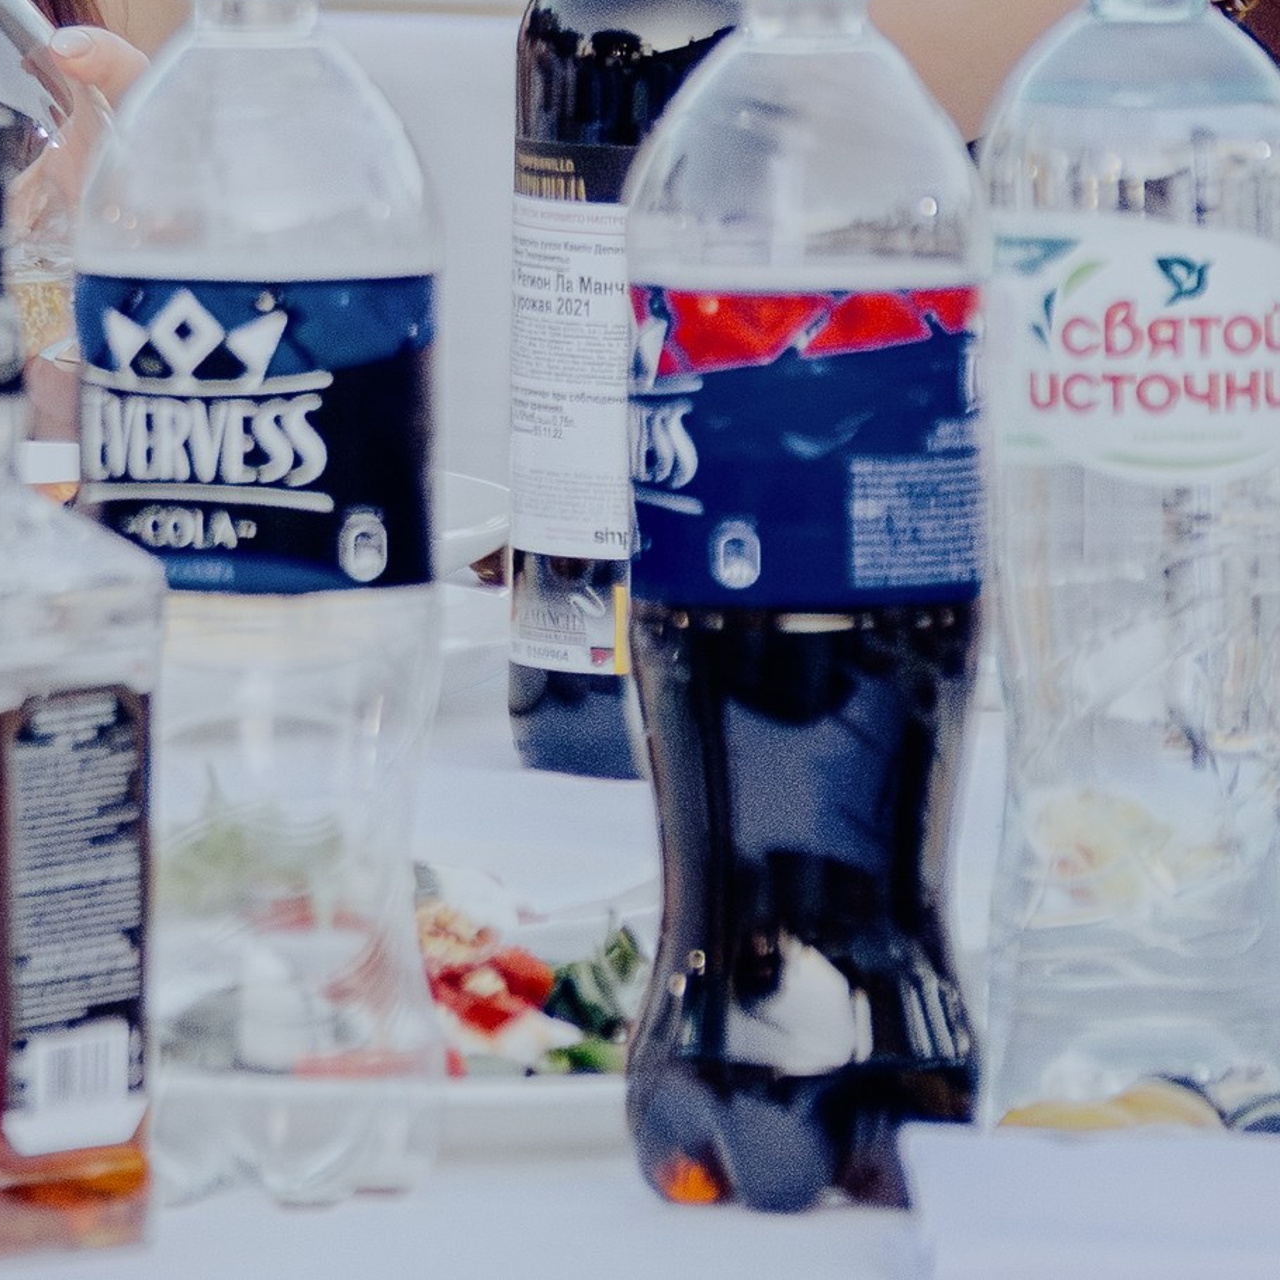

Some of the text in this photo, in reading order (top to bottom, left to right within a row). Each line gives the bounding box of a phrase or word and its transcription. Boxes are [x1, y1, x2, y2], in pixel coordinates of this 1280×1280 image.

[579, 276, 626, 296] Манч
[556, 297, 590, 318] 2021
[1028, 371, 1280, 415] источни
